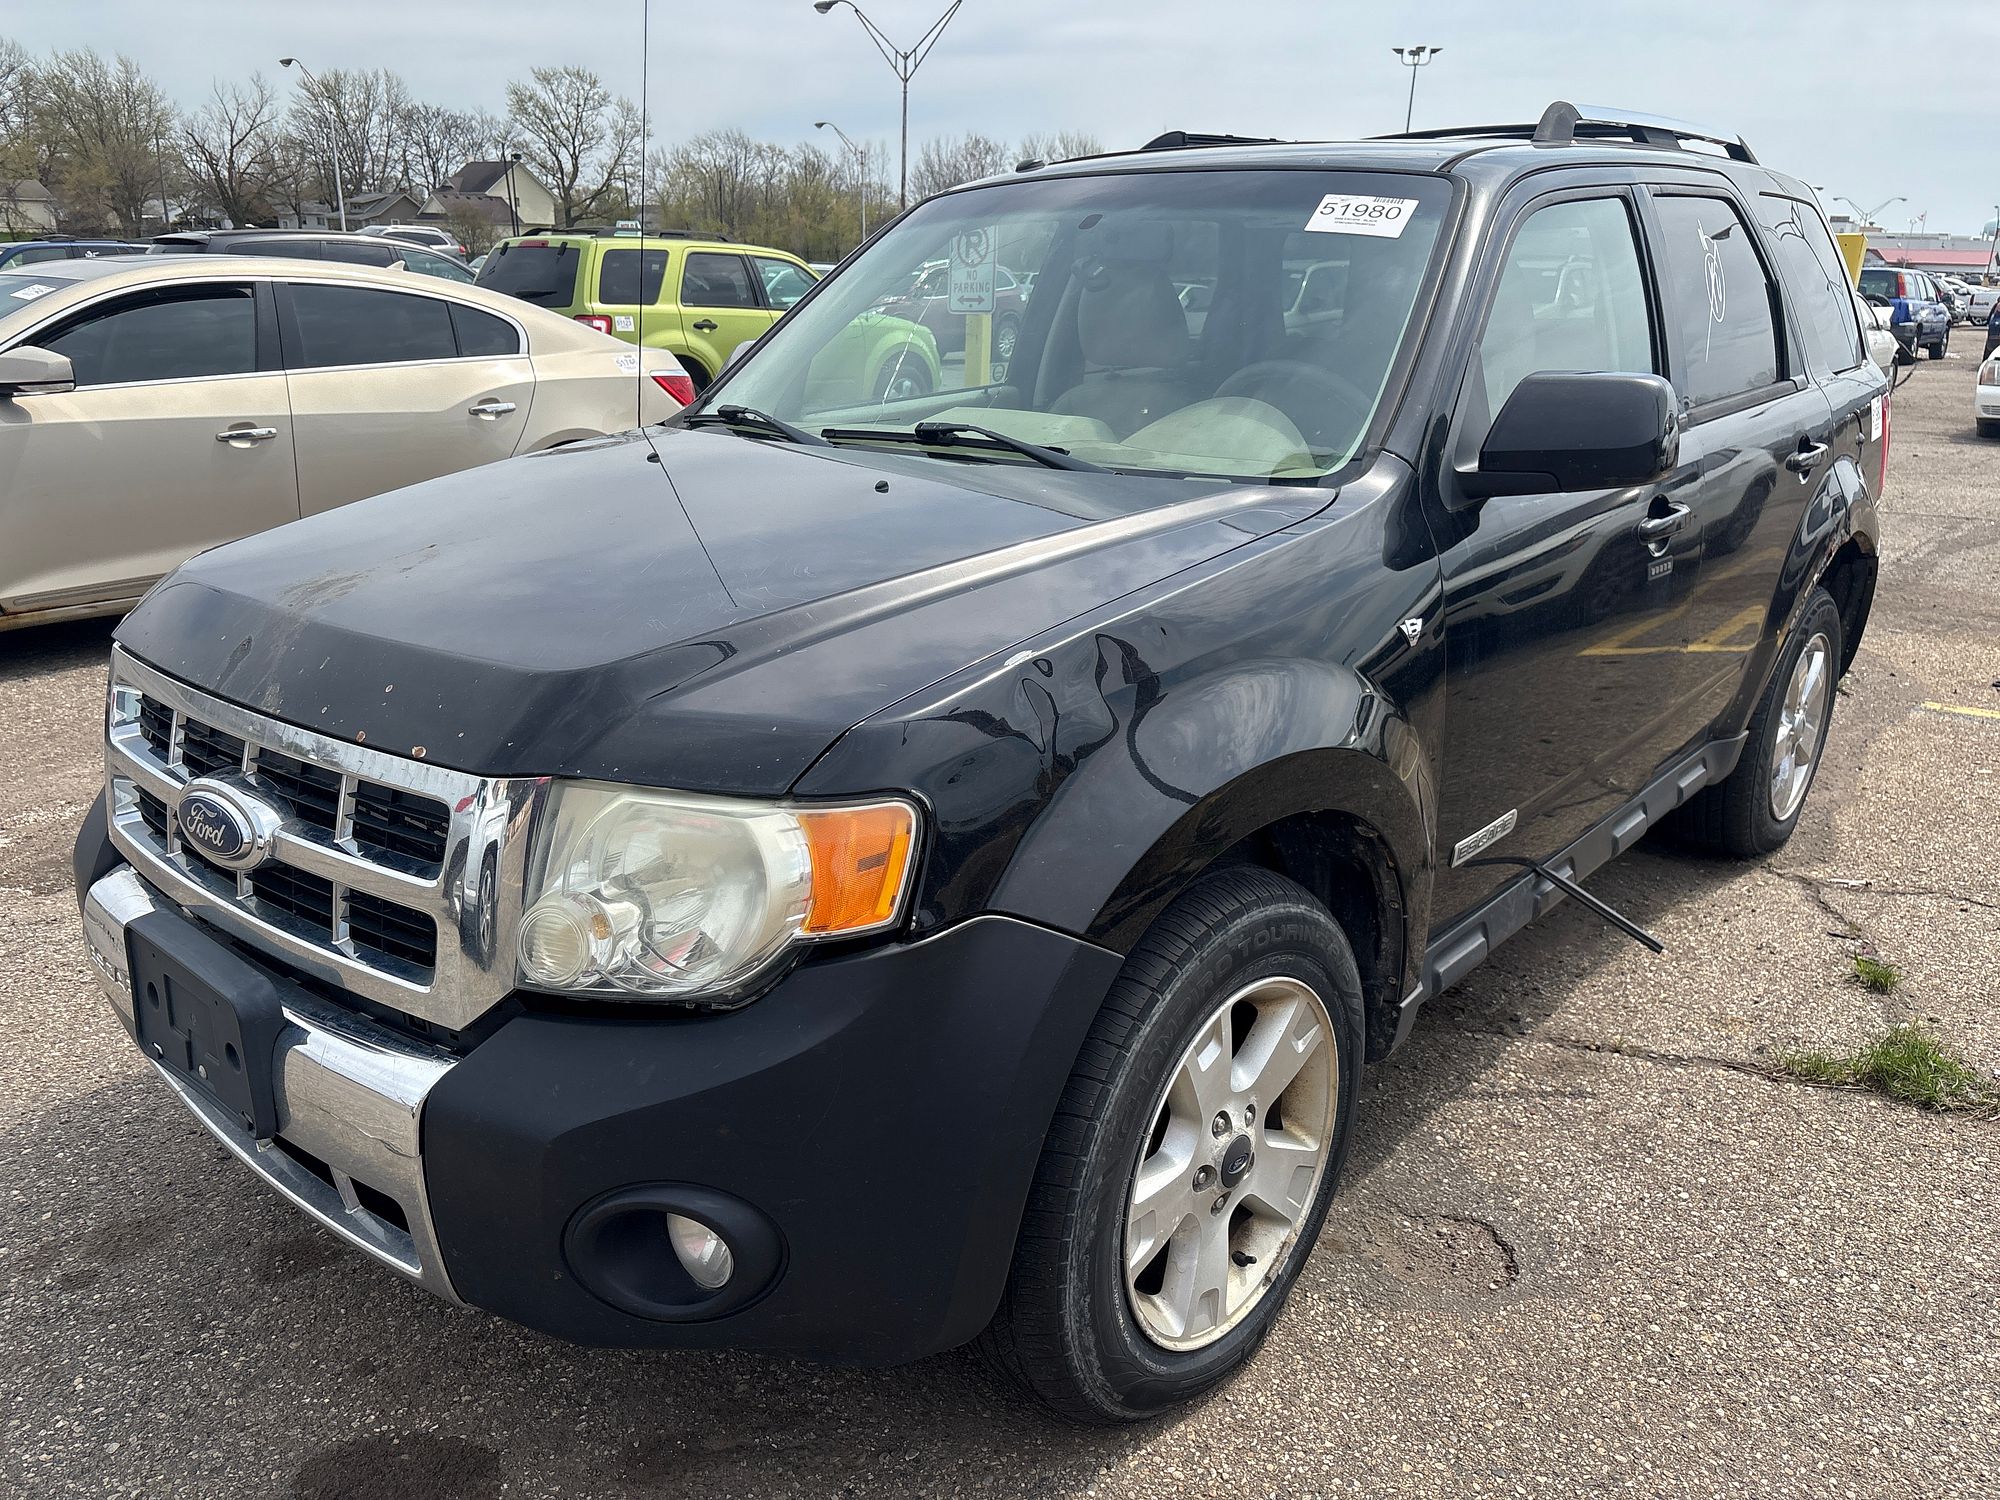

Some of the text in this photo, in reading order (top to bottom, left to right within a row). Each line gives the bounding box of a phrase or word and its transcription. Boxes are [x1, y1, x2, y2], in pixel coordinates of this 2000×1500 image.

[1320, 202, 1402, 220] 51980
[966, 269, 978, 281] NO
[953, 281, 991, 294] PARKING
[187, 802, 226, 847] Ford
[1458, 814, 1513, 859] ESCAPE
